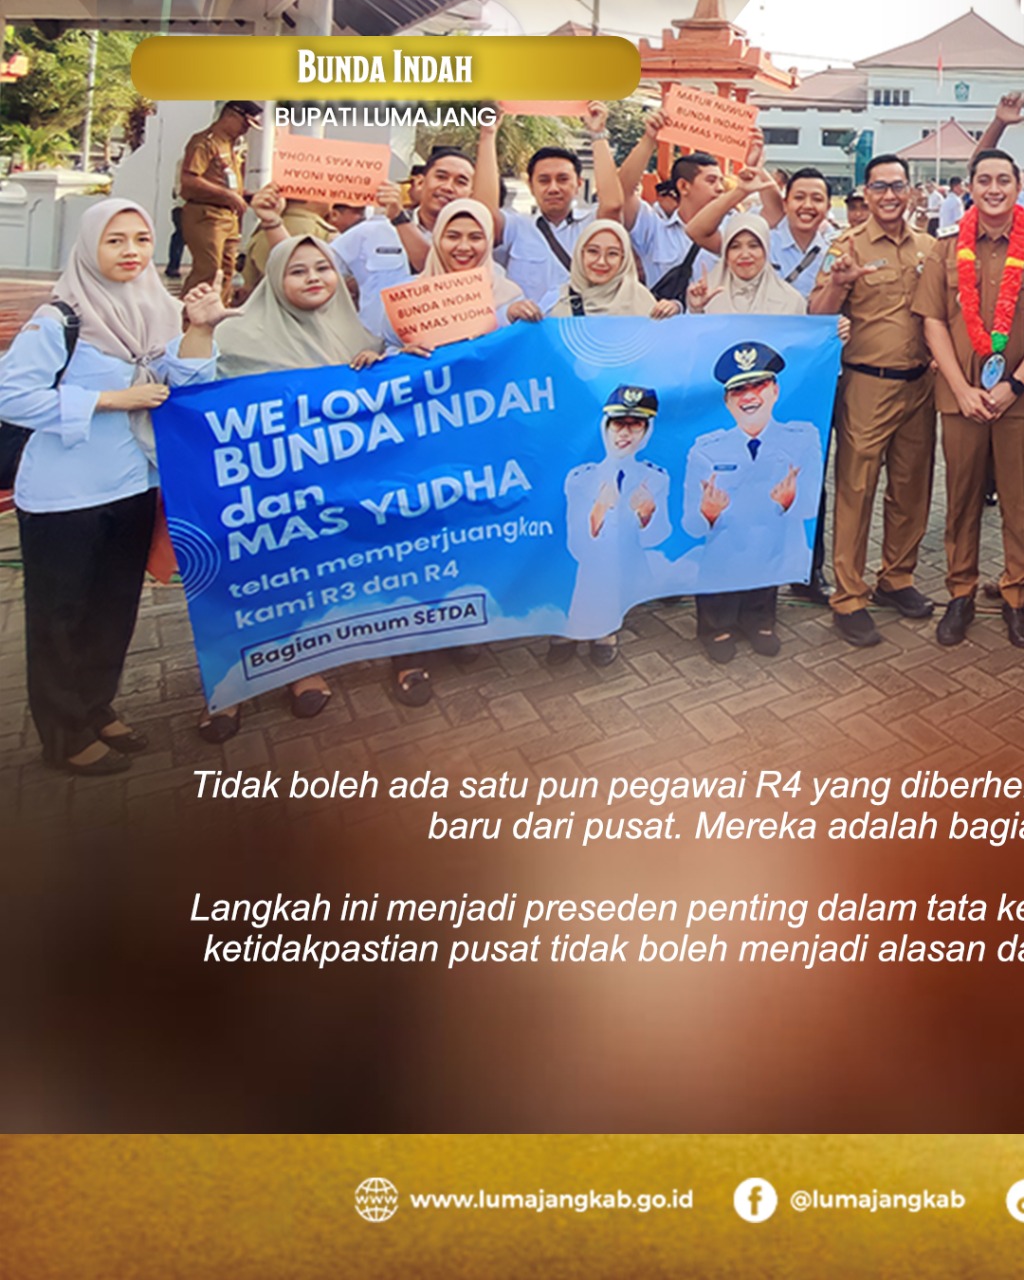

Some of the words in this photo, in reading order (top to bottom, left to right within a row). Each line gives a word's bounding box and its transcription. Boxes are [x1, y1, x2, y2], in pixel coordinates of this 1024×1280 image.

[676, 107, 711, 123] BUNDA
[713, 118, 746, 132] INDAH
[677, 91, 712, 107] MATUR
[714, 101, 753, 118] NUWUN
[664, 117, 688, 131] DAN
[689, 125, 712, 138] MAS
[713, 133, 747, 148] YUDHA
[388, 284, 431, 302] MATUR
[434, 274, 483, 291] NUWUN
[397, 300, 440, 319] BUNDA
[442, 291, 482, 307] INDAH
[420, 317, 449, 331] MAS
[452, 306, 494, 322] YUDHA
[204, 398, 286, 444] WE
[297, 375, 413, 428] LOVE
[423, 365, 452, 396] U
[213, 412, 405, 487] BUNDA
[413, 376, 555, 438] INDAH
[220, 483, 325, 529] dan
[228, 506, 349, 561] MAS
[360, 459, 532, 525] YUDHA
[228, 566, 310, 598] telah
[316, 516, 554, 577] memperjuangkan
[234, 590, 315, 629] kami
[321, 582, 356, 606] R3
[362, 569, 418, 596] dan
[424, 559, 460, 583] R4
[250, 632, 332, 668] Bagian
[336, 615, 409, 641] Umum
[413, 603, 477, 626] SETDA
